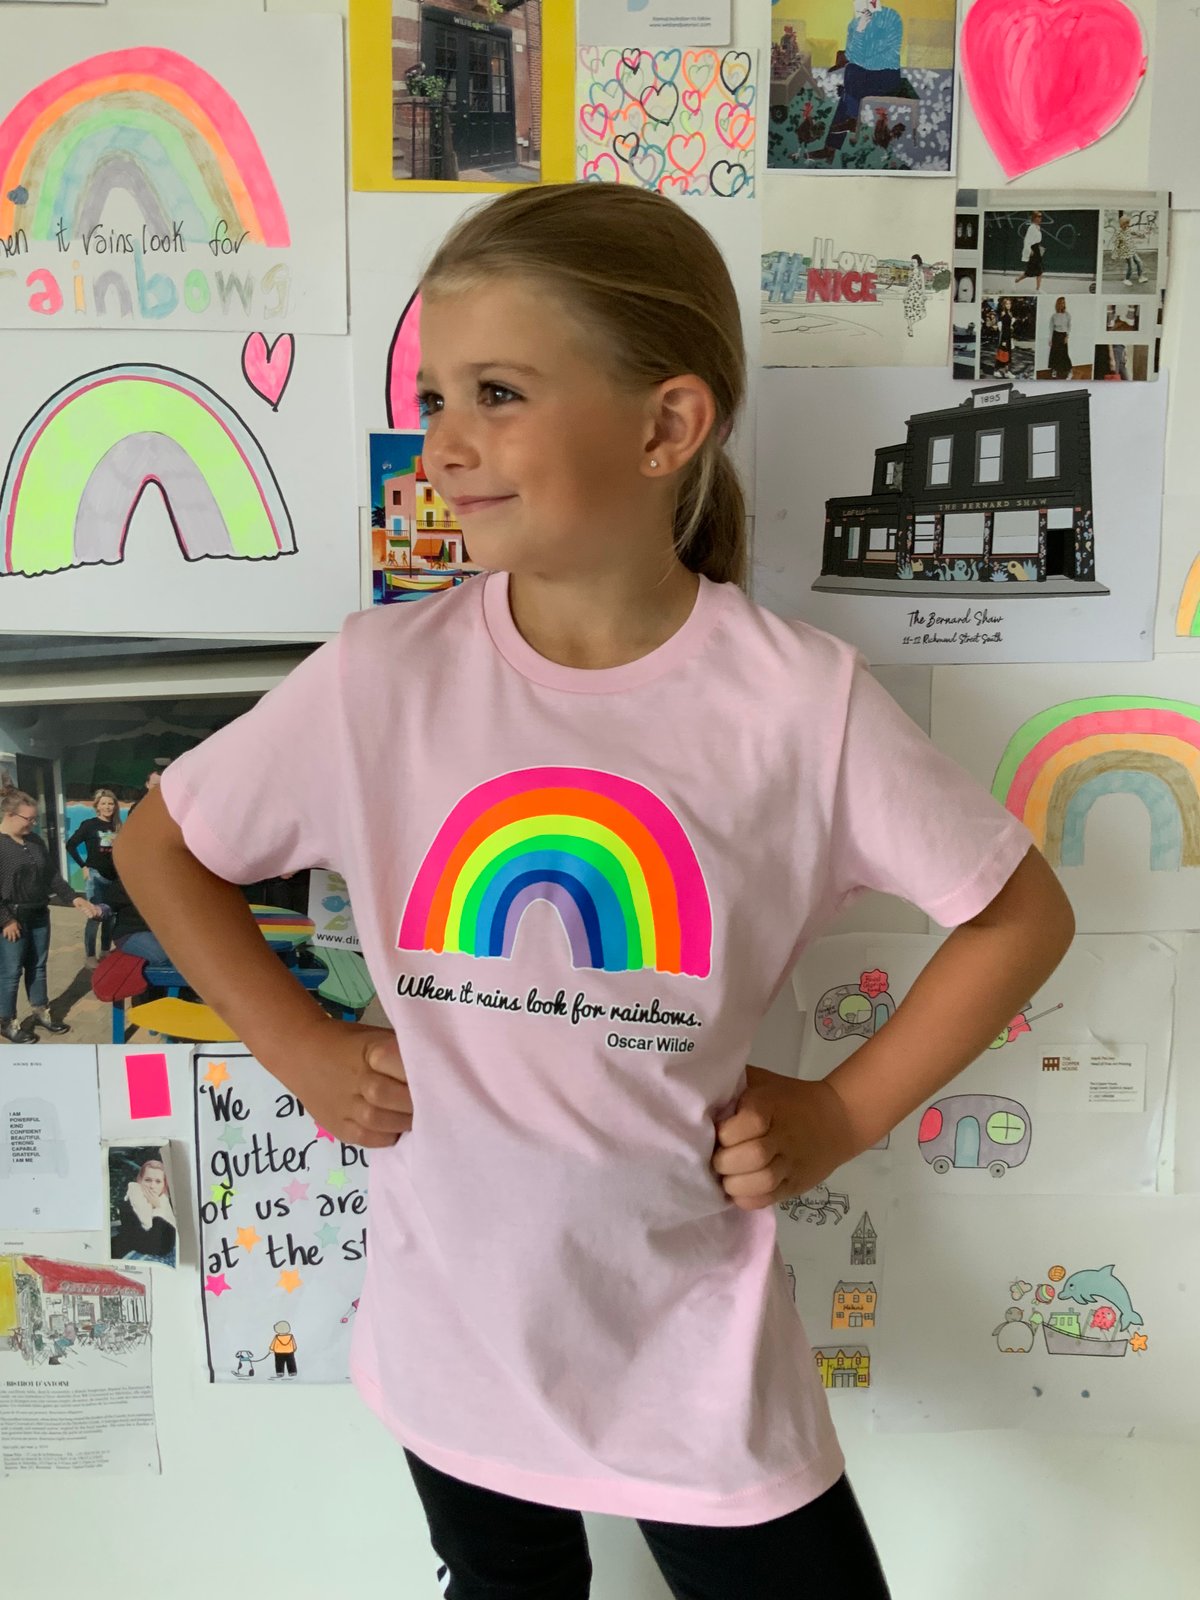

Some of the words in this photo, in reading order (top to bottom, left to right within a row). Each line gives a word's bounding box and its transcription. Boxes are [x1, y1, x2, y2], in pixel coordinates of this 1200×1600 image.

[56, 216, 70, 253] it
[82, 223, 135, 255] rains
[142, 220, 186, 255] look
[208, 219, 251, 256] for
[806, 267, 878, 303] NICE
[939, 503, 957, 511] THE
[962, 500, 1010, 510] BERNARD
[1016, 498, 1047, 507] SHAW
[907, 609, 925, 627] The
[925, 608, 972, 628] Bernard
[973, 608, 1004, 627] Shaw
[396, 973, 456, 1002] When
[459, 981, 474, 1004] it
[476, 989, 523, 1012] rains
[526, 987, 568, 1016] look
[571, 992, 606, 1025] for
[609, 998, 703, 1027] rainbows.
[607, 1033, 654, 1051] Oscar
[656, 1036, 695, 1053] Wilde
[200, 1189, 234, 1225] of
[255, 1198, 291, 1220] us
[316, 1189, 368, 1217] are
[208, 1237, 240, 1274] at
[265, 1233, 324, 1269] the
